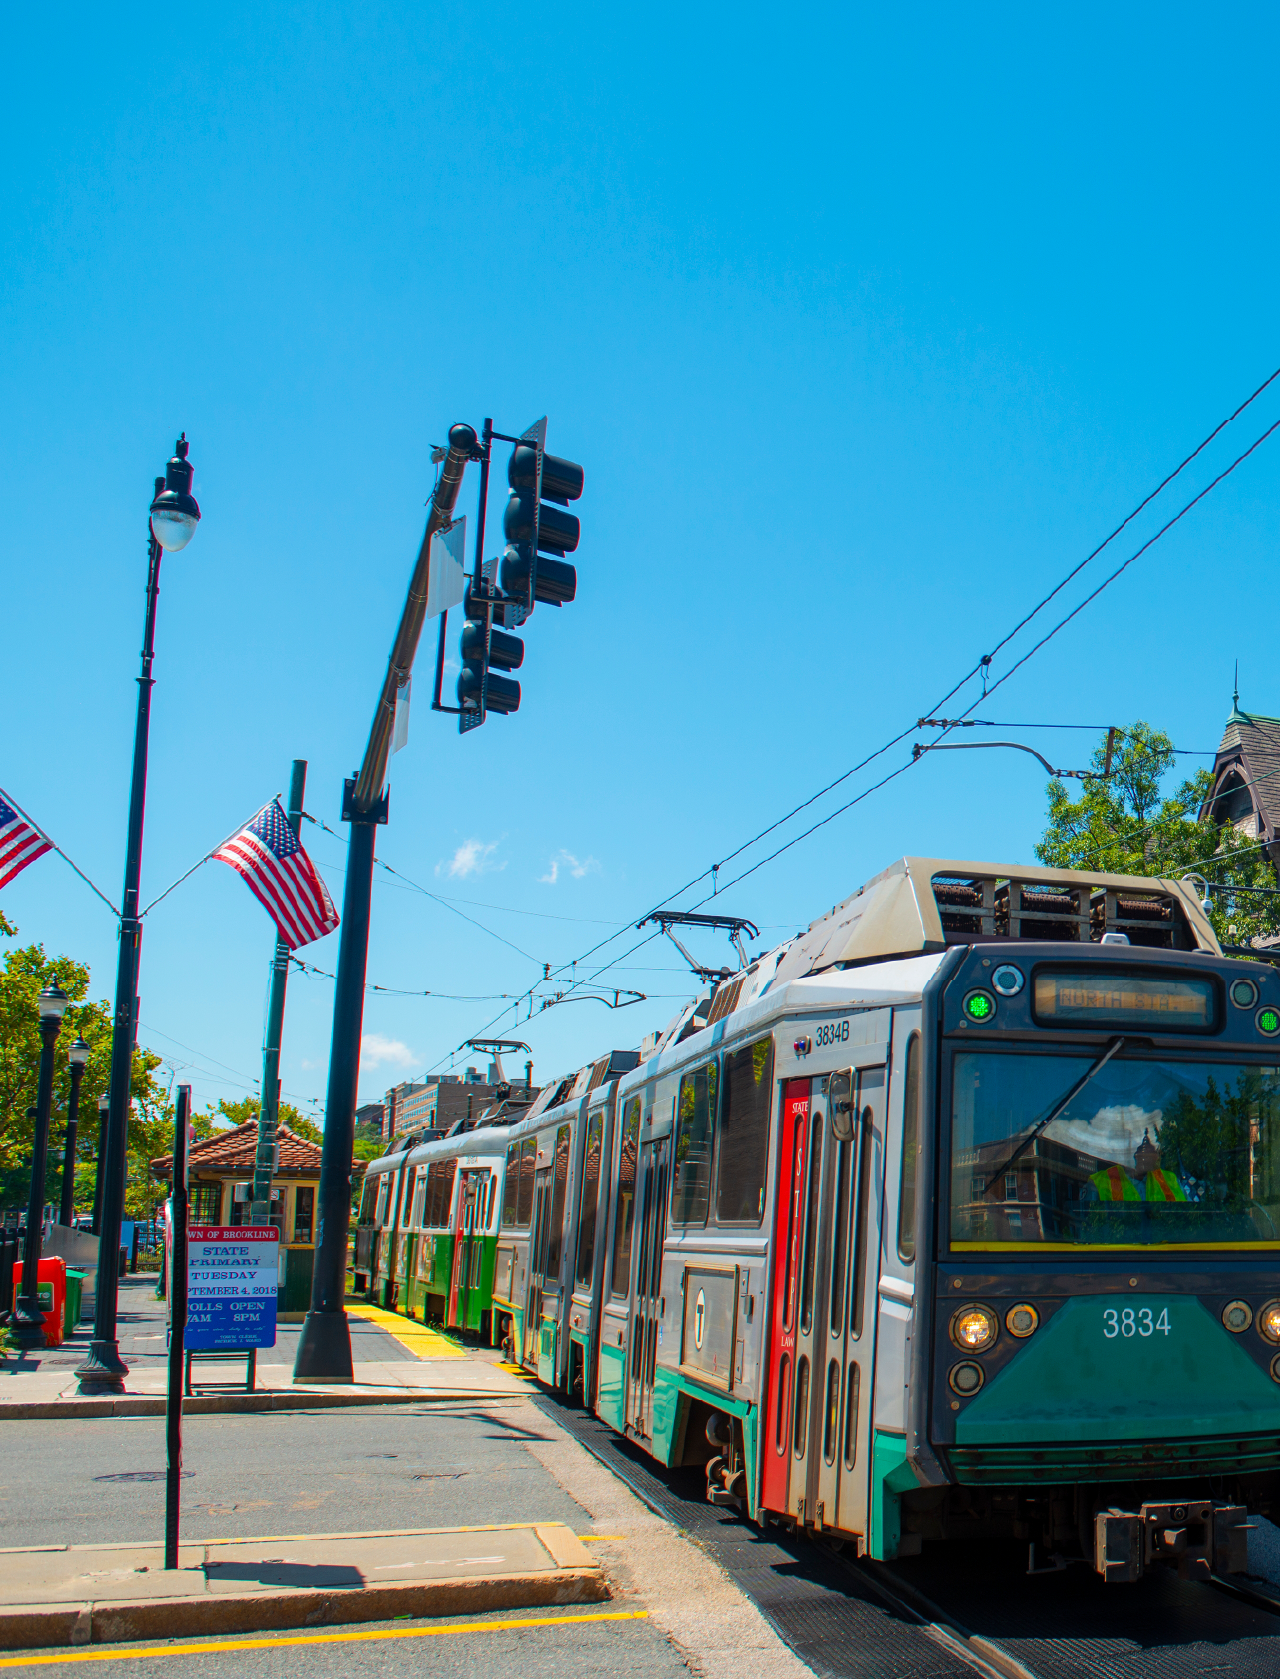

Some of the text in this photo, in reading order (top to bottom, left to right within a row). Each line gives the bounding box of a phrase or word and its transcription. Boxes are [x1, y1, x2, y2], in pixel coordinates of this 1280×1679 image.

[1061, 990, 1178, 1010] NORTH STA.
[815, 1020, 850, 1047] 3834B
[792, 1101, 808, 1113] STATE
[188, 1231, 204, 1239] WN
[223, 1231, 276, 1239] BROOKLINE
[203, 1246, 250, 1256] STATE
[189, 1258, 261, 1267] PRIMARY
[191, 1271, 258, 1280] TUESDAY
[241, 1287, 251, 1296] 4,
[253, 1286, 277, 1295] 2018
[187, 1301, 266, 1311] OLLS OPEN
[187, 1313, 212, 1323] 7AM
[233, 1313, 261, 1322] 8PM
[1103, 1307, 1172, 1338] 3834
[781, 1336, 794, 1348] LAW
